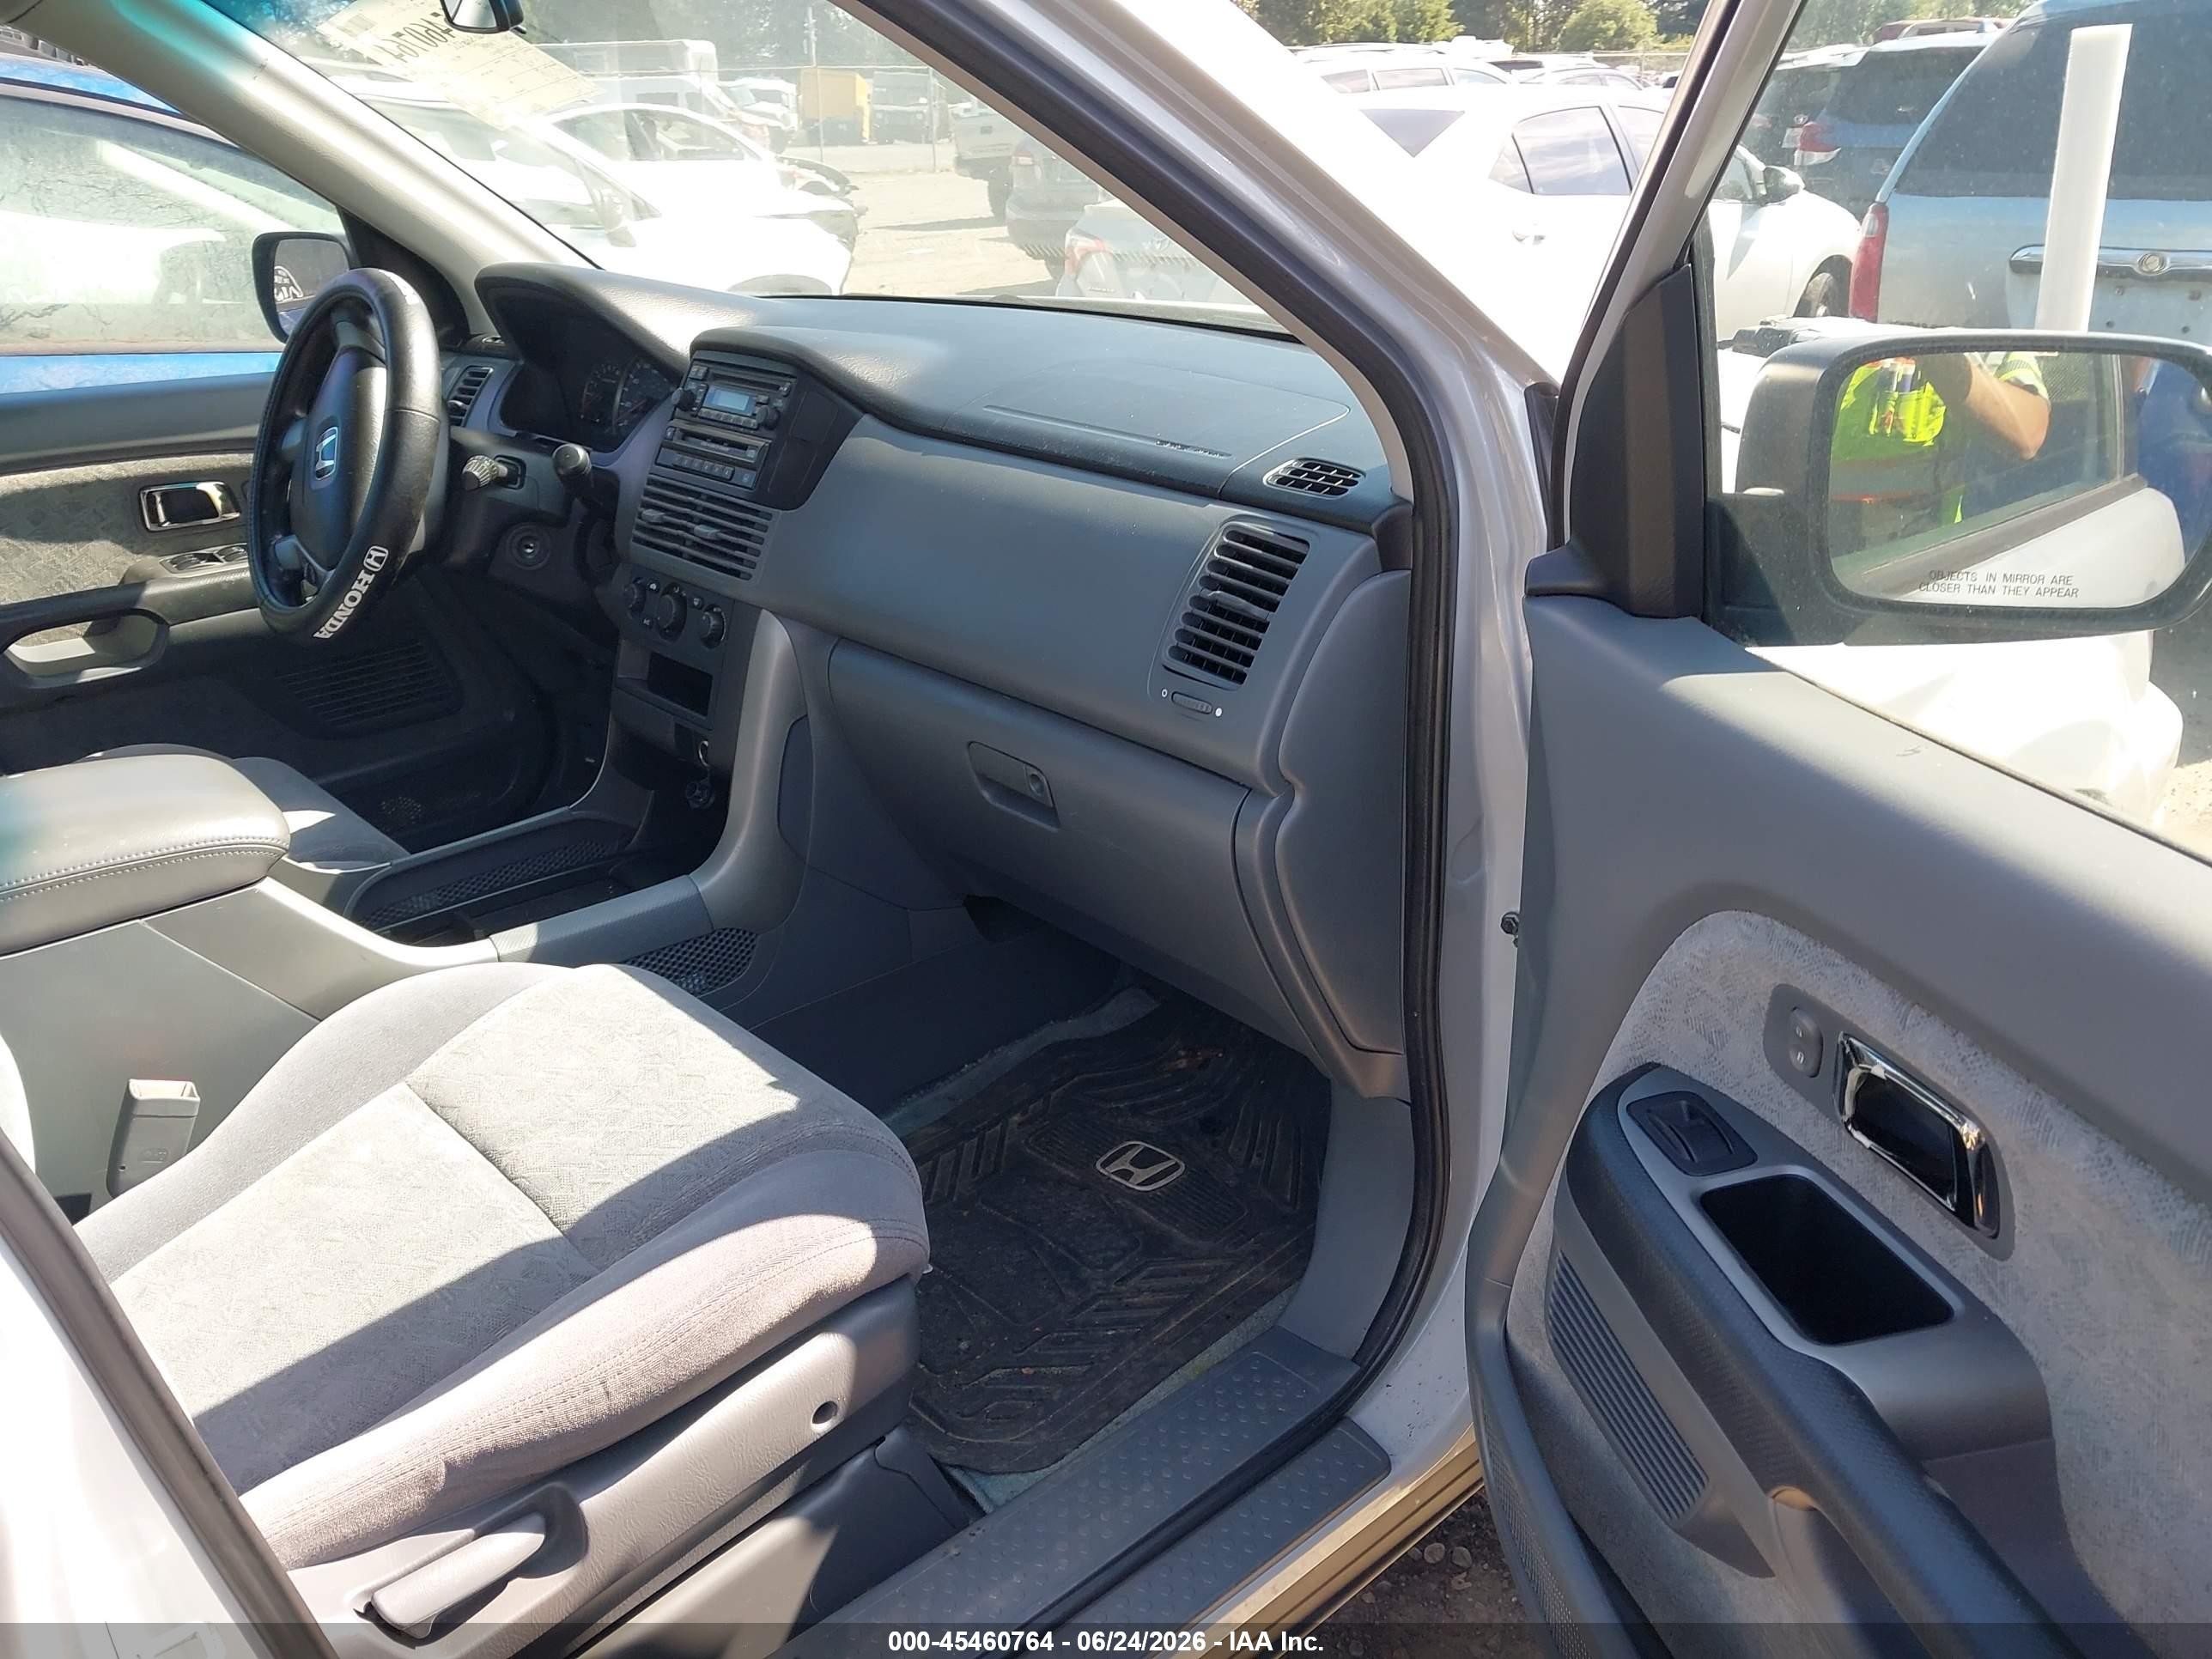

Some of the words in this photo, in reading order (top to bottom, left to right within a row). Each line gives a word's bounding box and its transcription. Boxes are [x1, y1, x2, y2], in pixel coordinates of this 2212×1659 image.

[1929, 570, 1978, 582] OBJECTS
[1985, 572, 1996, 582] IN
[2002, 573, 2045, 585] MIRROR
[2050, 574, 2074, 586] ARE
[1918, 581, 1961, 593] CLOSER
[1966, 584, 1996, 595] THAN
[2002, 585, 2029, 596] THEY
[2035, 586, 2080, 598] APPEAR
[313, 569, 376, 639] HONDA
